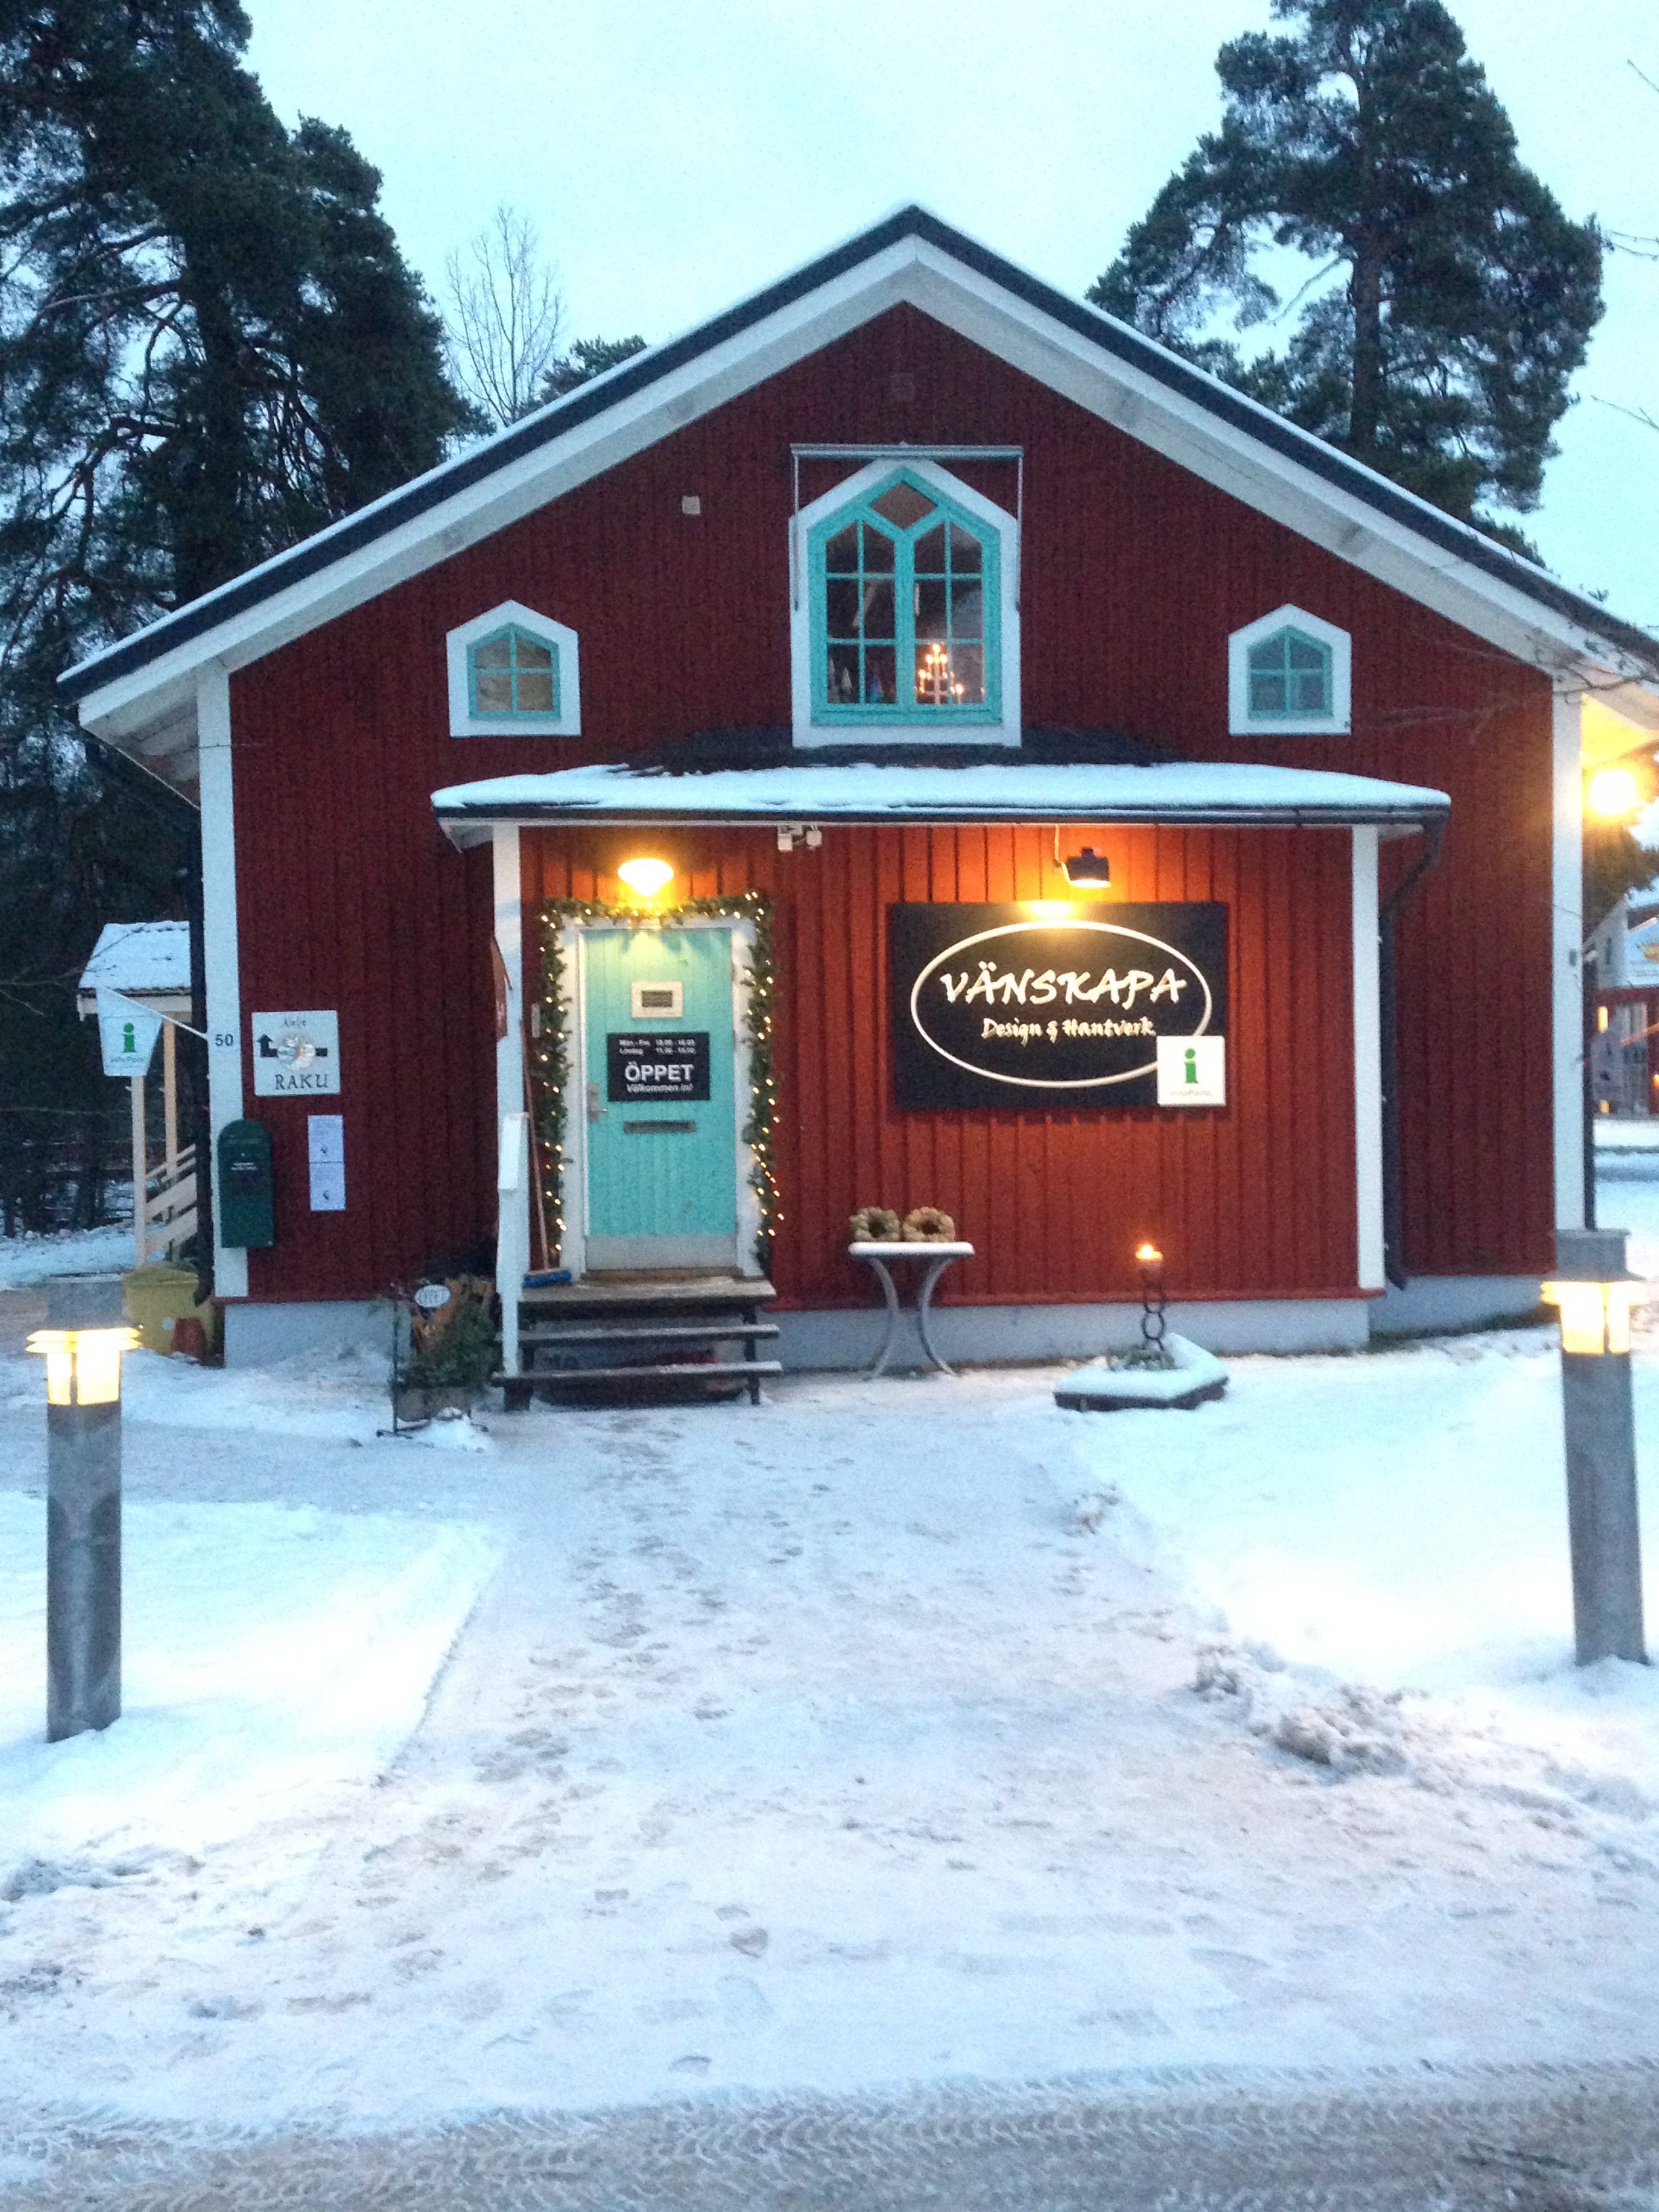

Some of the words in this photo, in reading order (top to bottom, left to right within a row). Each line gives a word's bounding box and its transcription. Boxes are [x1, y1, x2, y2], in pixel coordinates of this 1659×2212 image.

[940, 960, 1187, 1010] VÄNSKAPA
[215, 1033, 234, 1046] 50
[981, 1018, 1043, 1047] Design
[1062, 1017, 1157, 1038] Hantverk
[624, 1061, 695, 1083] ÖPPET
[275, 1074, 328, 1090] RAKU
[626, 1084, 680, 1093] Välkommen
